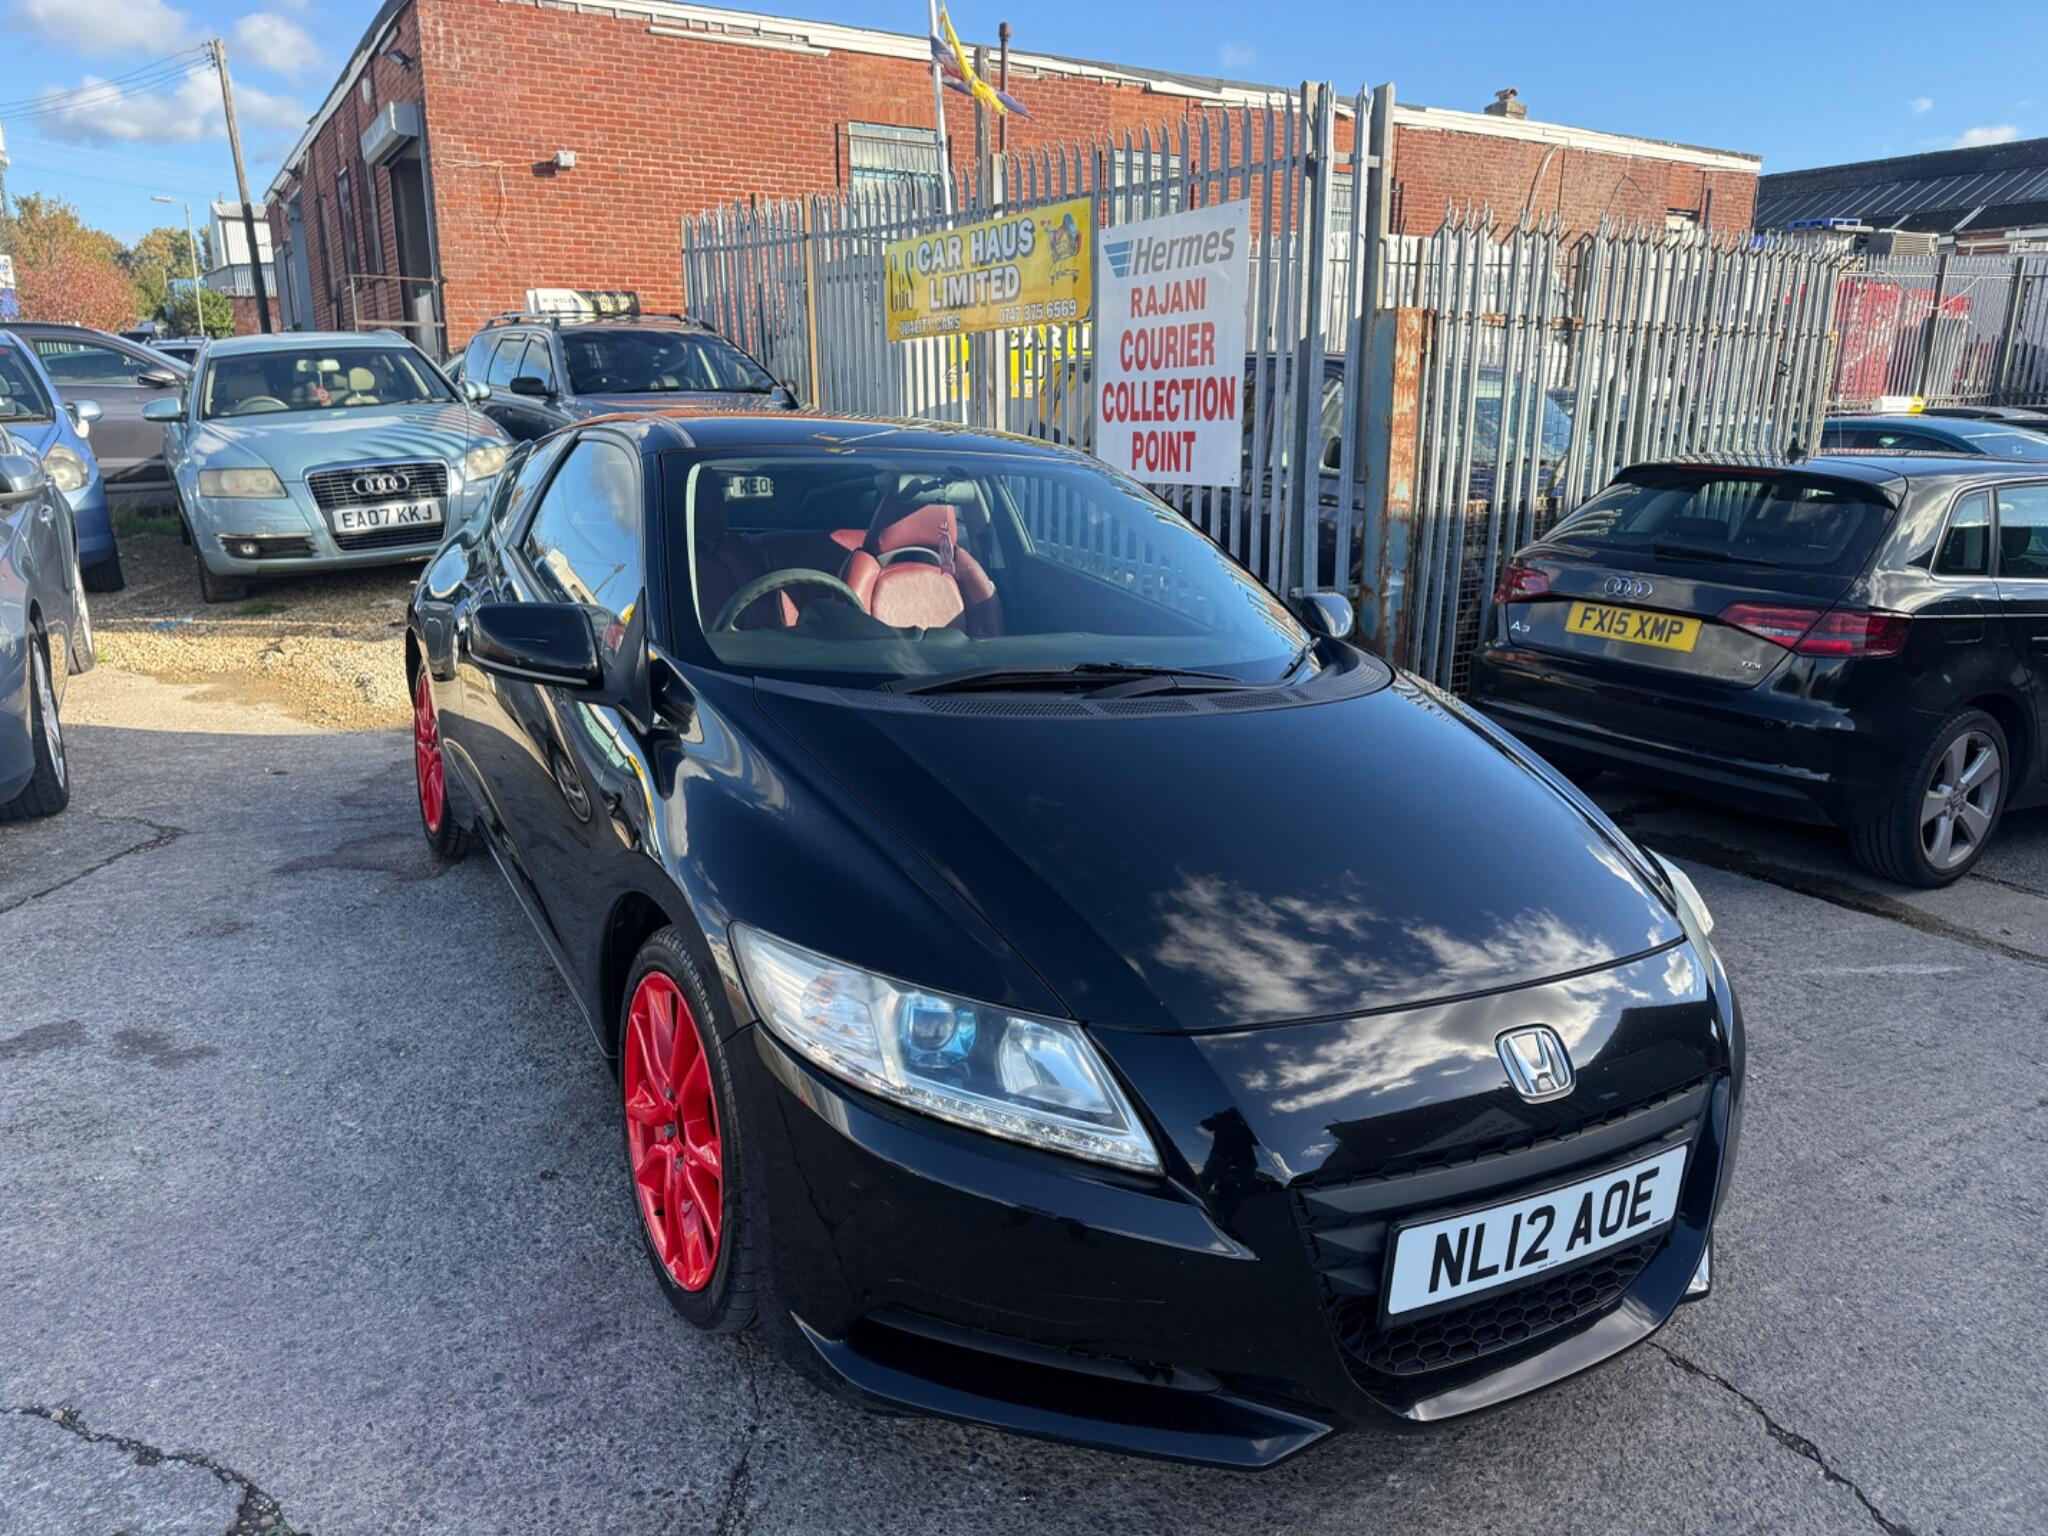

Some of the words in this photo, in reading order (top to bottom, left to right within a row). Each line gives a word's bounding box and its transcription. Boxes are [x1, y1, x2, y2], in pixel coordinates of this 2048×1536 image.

[917, 234, 963, 275] CAR
[970, 218, 1035, 265] HAUS
[1133, 227, 1236, 276] Hermes
[930, 264, 1021, 311] LIMITED
[1046, 298, 1077, 319] 6569
[1130, 277, 1206, 319] RAJANI
[899, 317, 934, 337] QUALITY
[935, 314, 961, 333] CARS
[1120, 321, 1215, 372] COURIER
[1102, 375, 1236, 423] COLLECTION
[1131, 430, 1197, 473] POINT
[342, 508, 390, 528] EA07
[396, 504, 433, 523] KKJ
[1579, 606, 1632, 636] FX15
[1633, 614, 1685, 643] XMP
[1428, 1205, 1556, 1294] NL12
[1566, 1166, 1660, 1252] AOE
